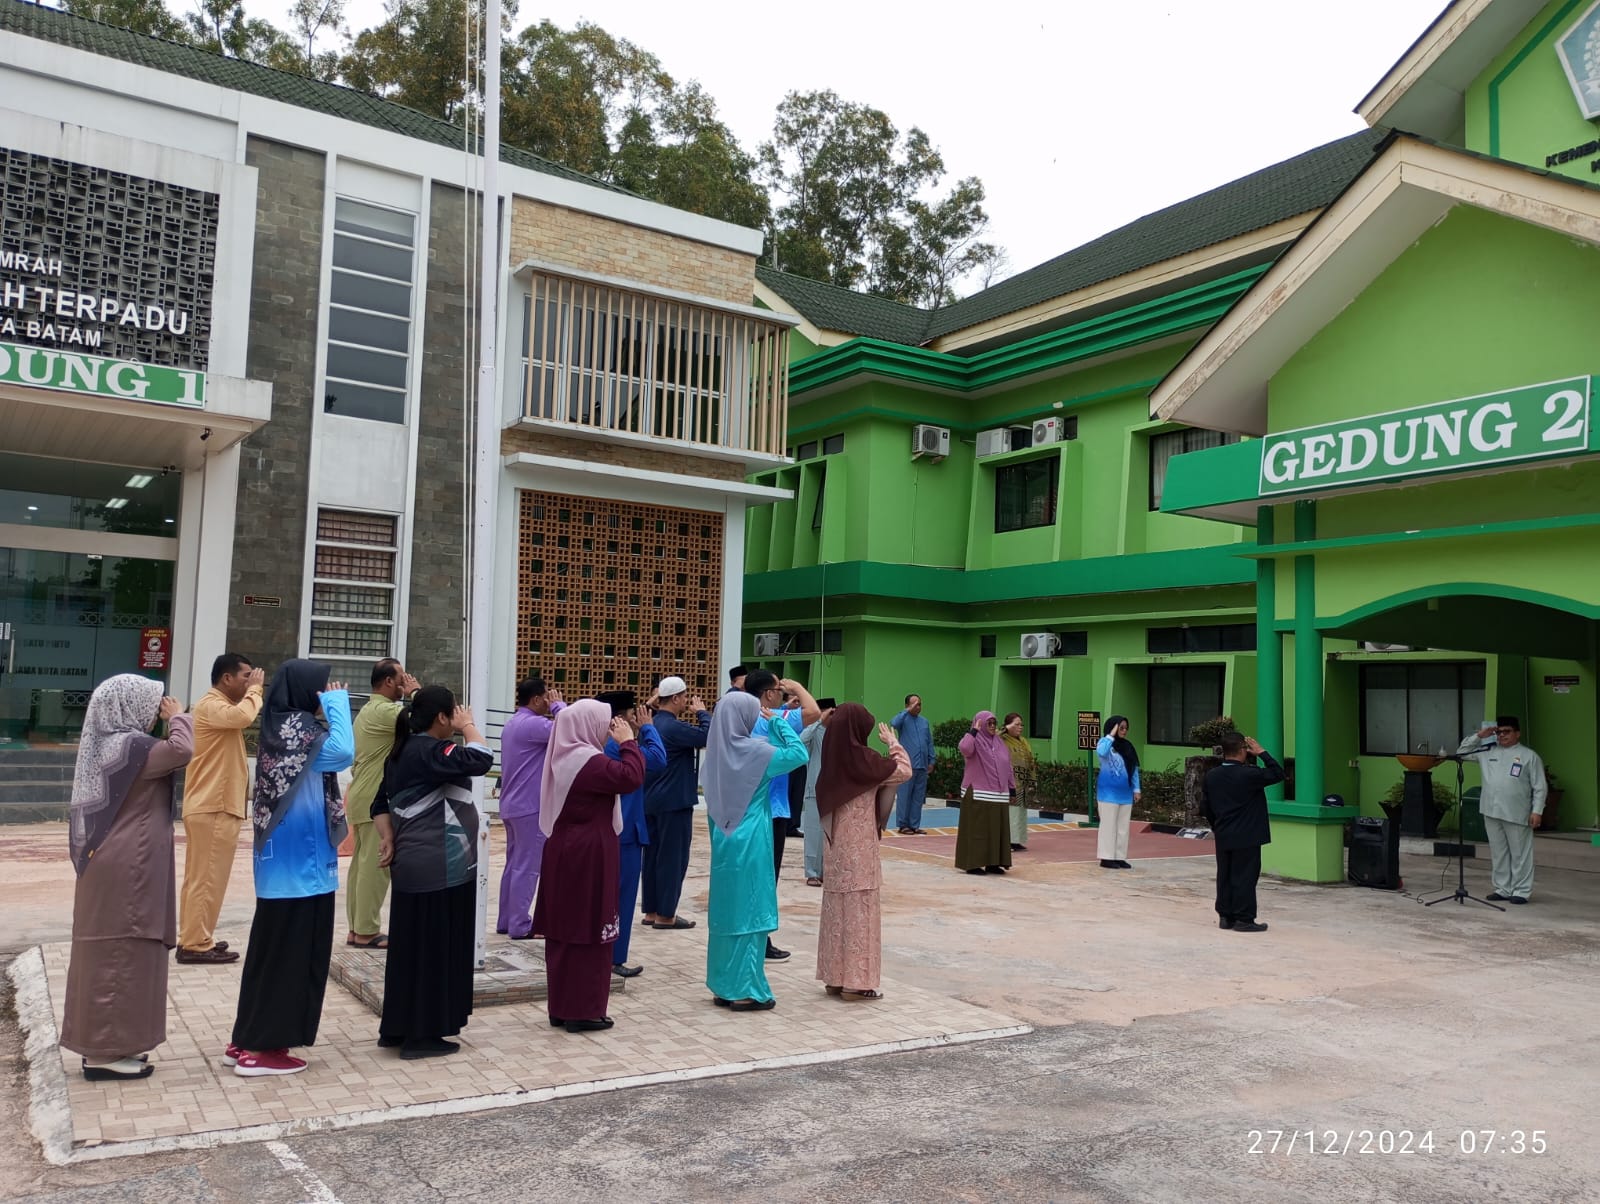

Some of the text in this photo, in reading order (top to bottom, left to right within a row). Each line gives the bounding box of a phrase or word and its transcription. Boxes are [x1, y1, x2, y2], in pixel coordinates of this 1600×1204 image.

[35, 286, 188, 336] TERPADU
[26, 320, 101, 348] BATAM
[176, 372, 203, 405] 1
[1263, 389, 1584, 484] GEDUNG 2
